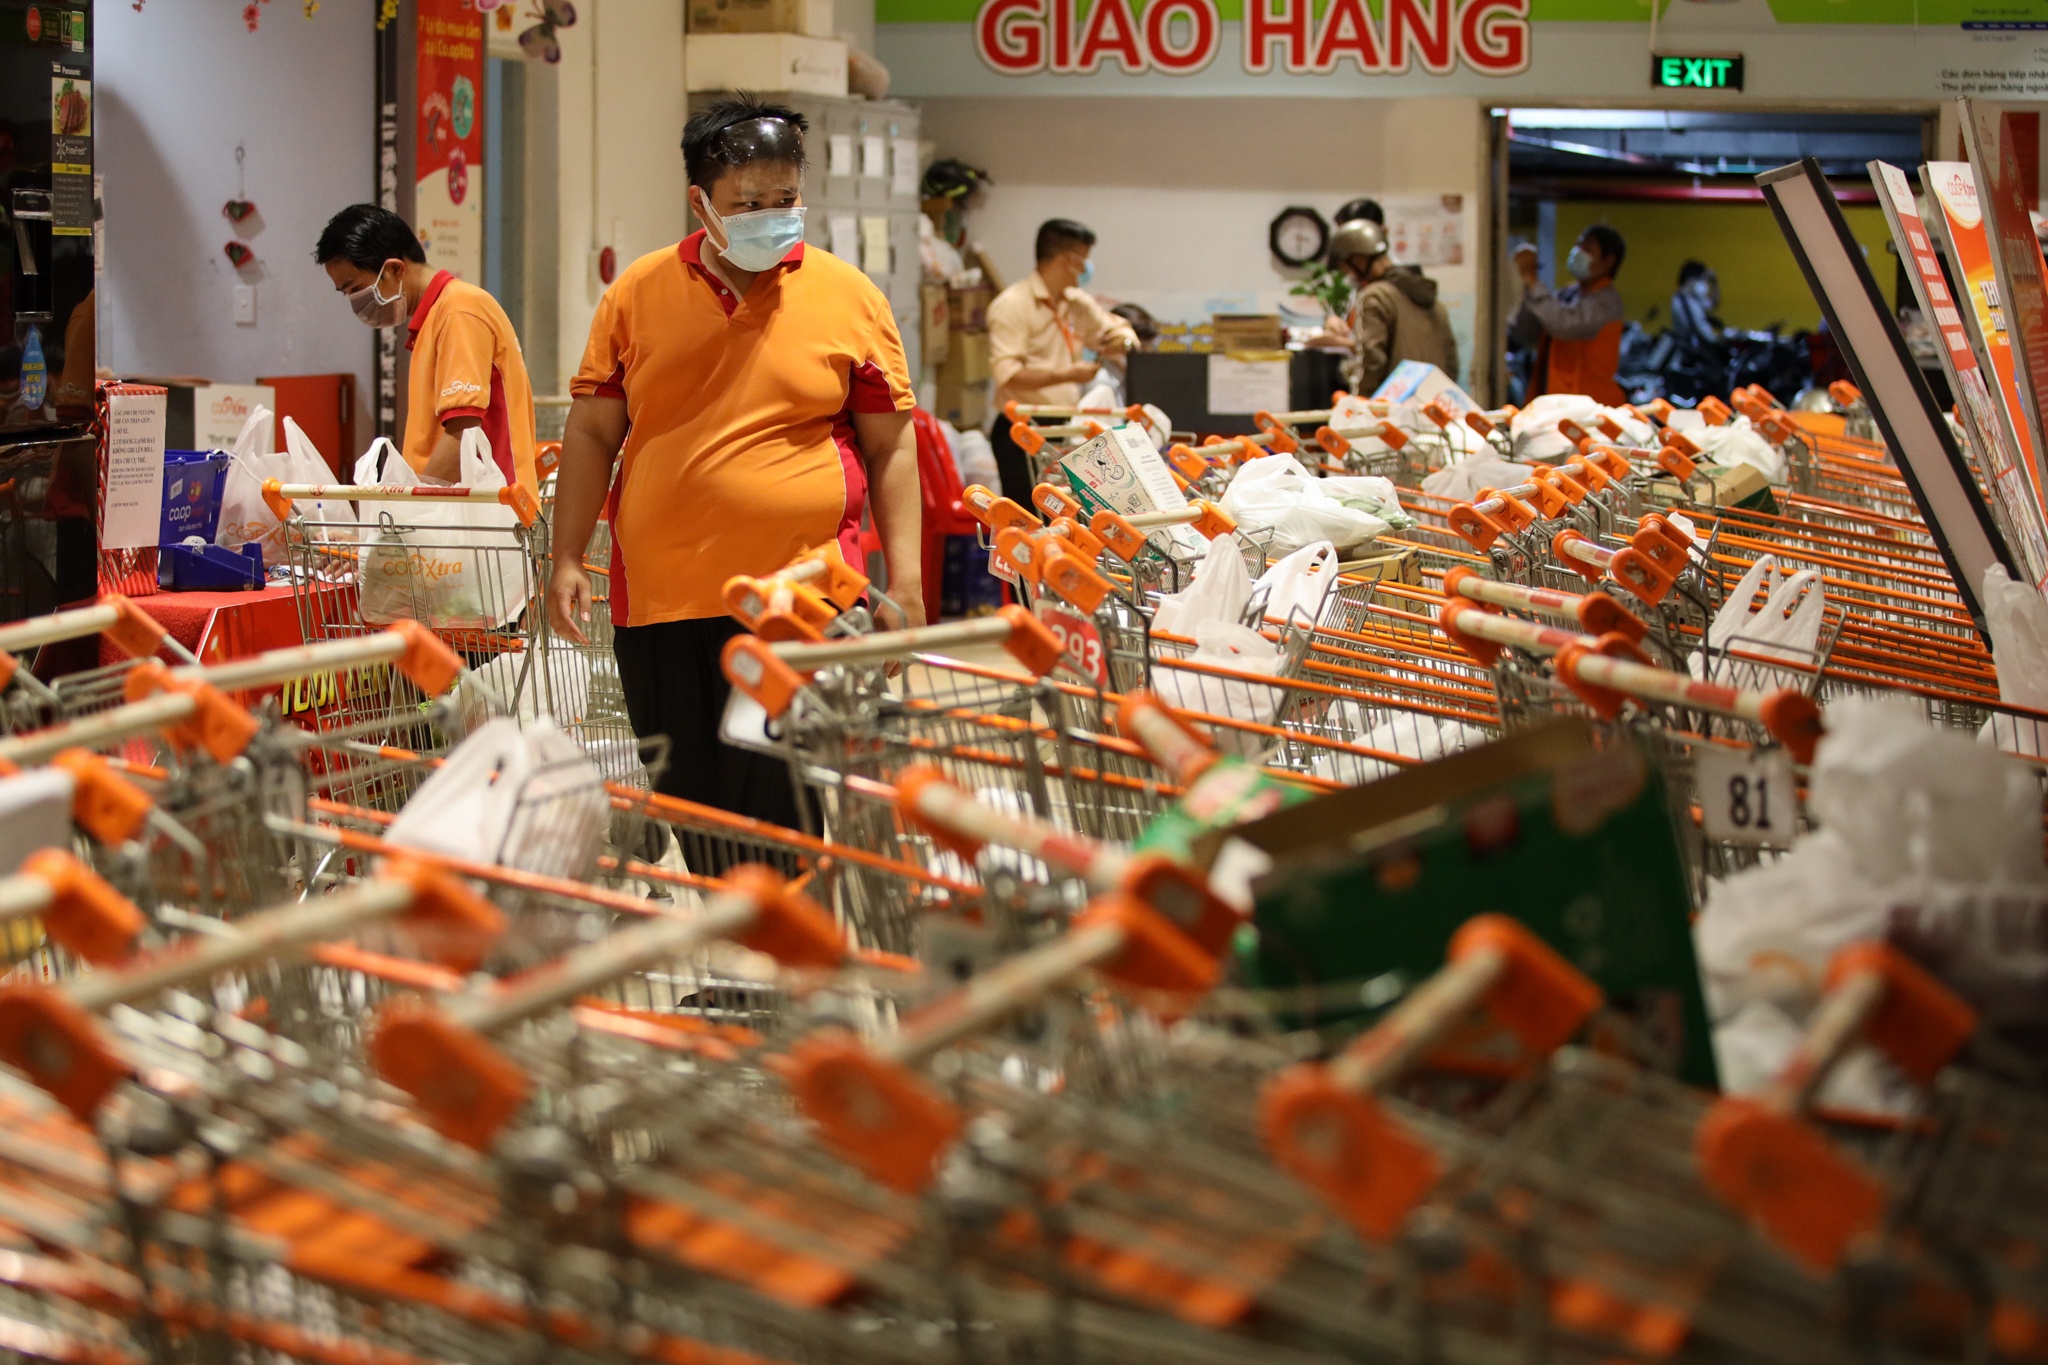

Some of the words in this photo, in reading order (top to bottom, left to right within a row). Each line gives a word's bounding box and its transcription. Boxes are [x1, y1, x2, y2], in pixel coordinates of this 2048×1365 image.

[979, 0, 1217, 71] GIAO
[1662, 57, 1732, 87] EXIT
[1728, 774, 1771, 830] 81
